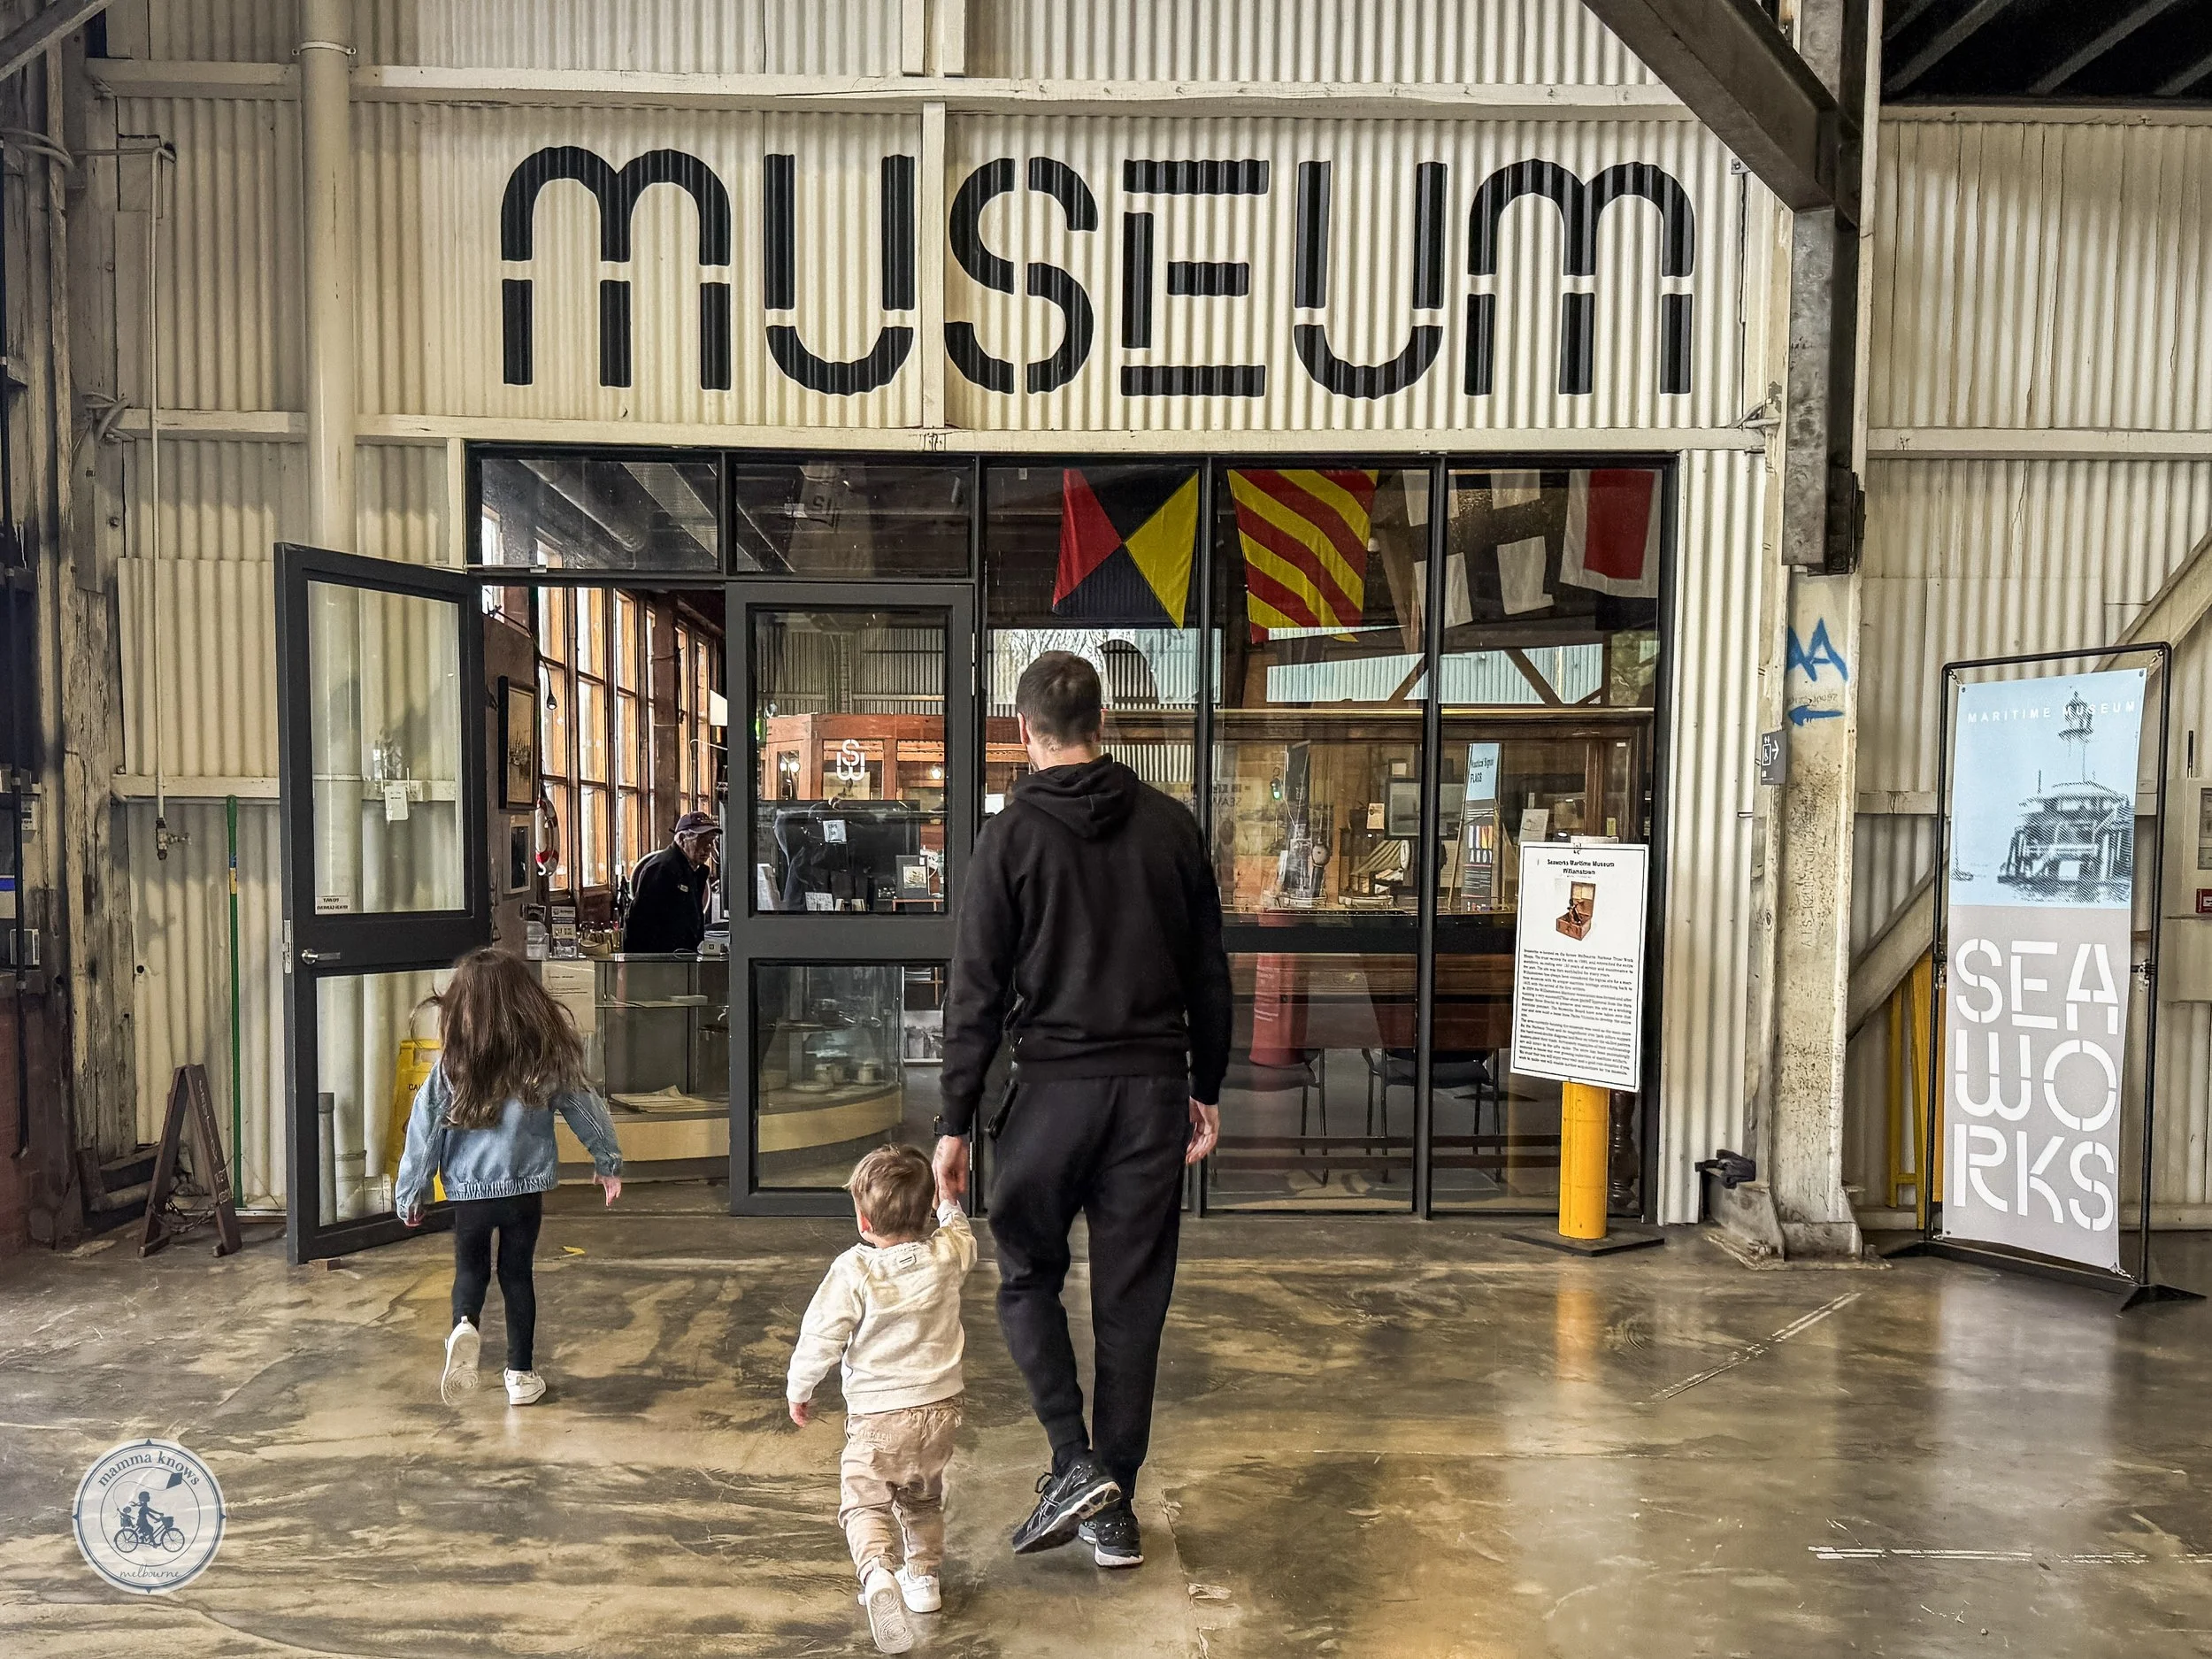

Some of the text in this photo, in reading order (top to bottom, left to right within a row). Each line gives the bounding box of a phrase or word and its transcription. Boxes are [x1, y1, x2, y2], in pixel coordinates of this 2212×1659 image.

[501, 145, 1694, 400] MUSEUM
[1967, 701, 2135, 724] MARITIME MUSEUM
[1955, 939, 2119, 1034] SEA
[1955, 1029, 2117, 1132] WO
[1954, 1124, 2115, 1232] RKS
